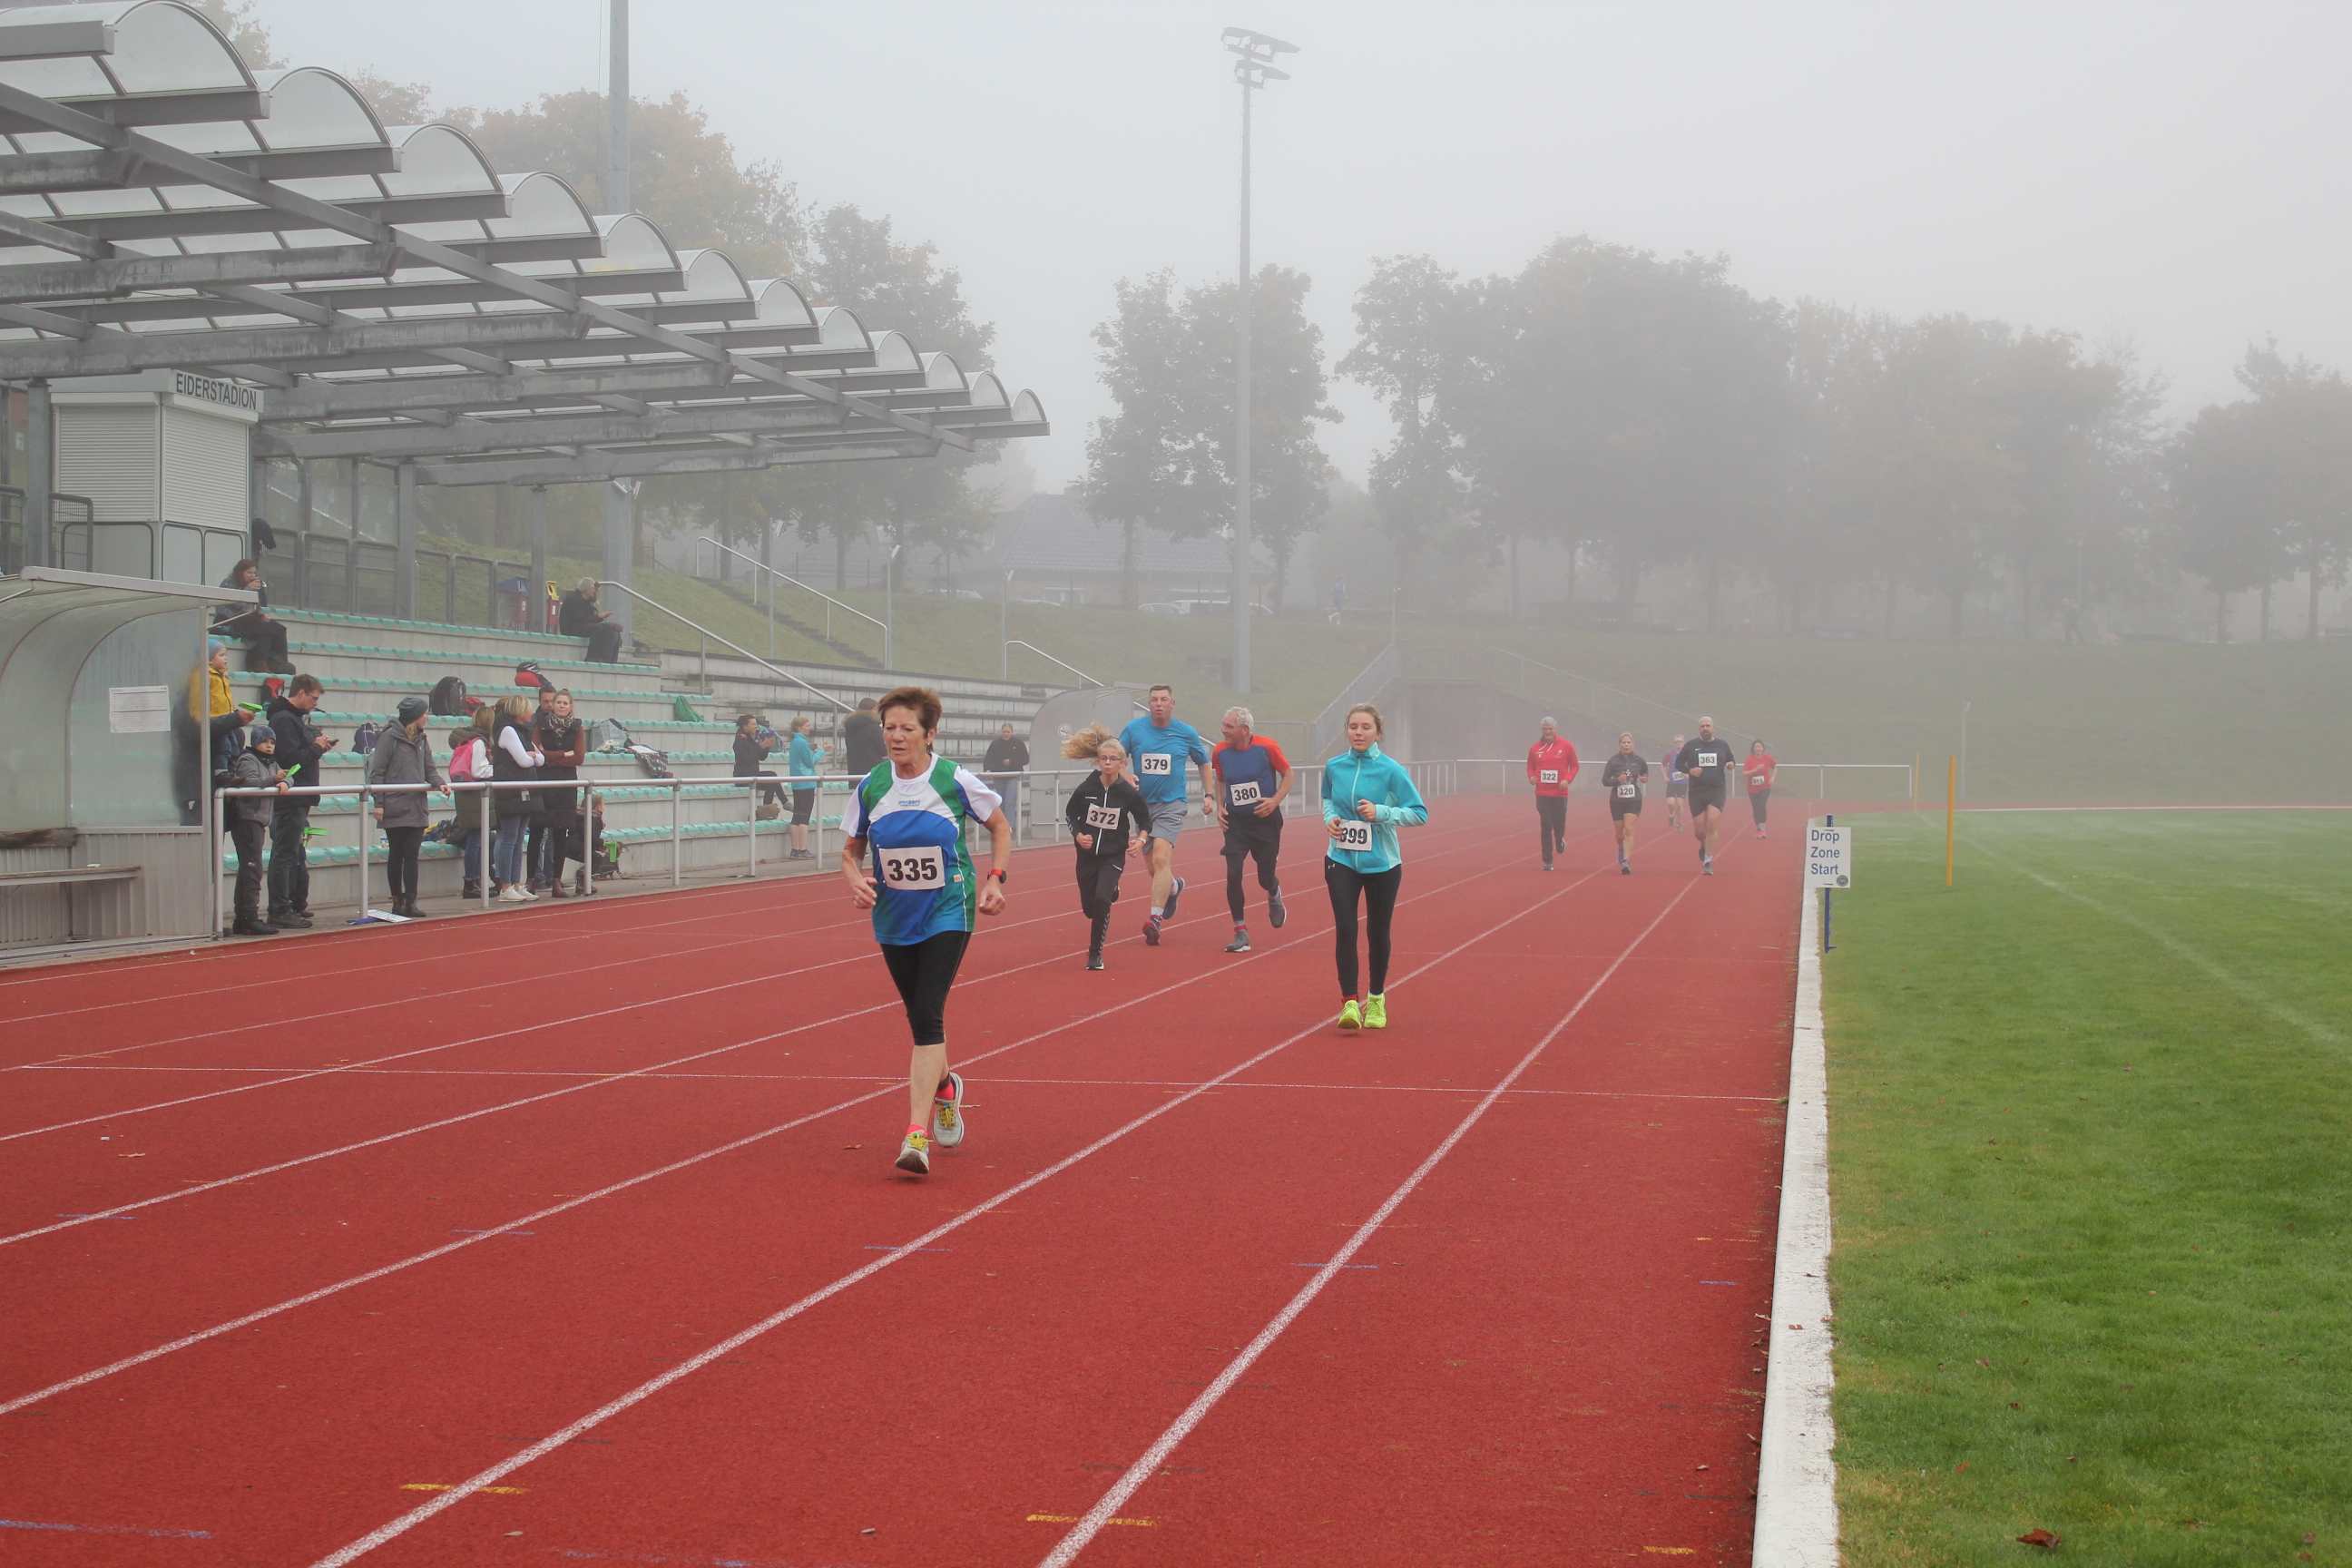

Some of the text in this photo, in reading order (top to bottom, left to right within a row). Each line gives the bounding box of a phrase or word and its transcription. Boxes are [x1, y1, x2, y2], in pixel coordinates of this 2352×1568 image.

[176, 373, 257, 410] EIDERSTADION
[1144, 759, 1168, 770] 379
[1234, 787, 1258, 800] 380
[1090, 810, 1116, 825] 372
[1811, 829, 1840, 844] Drop
[1810, 846, 1840, 858] Zone
[887, 858, 937, 881] 335
[1810, 862, 1838, 876] Start
